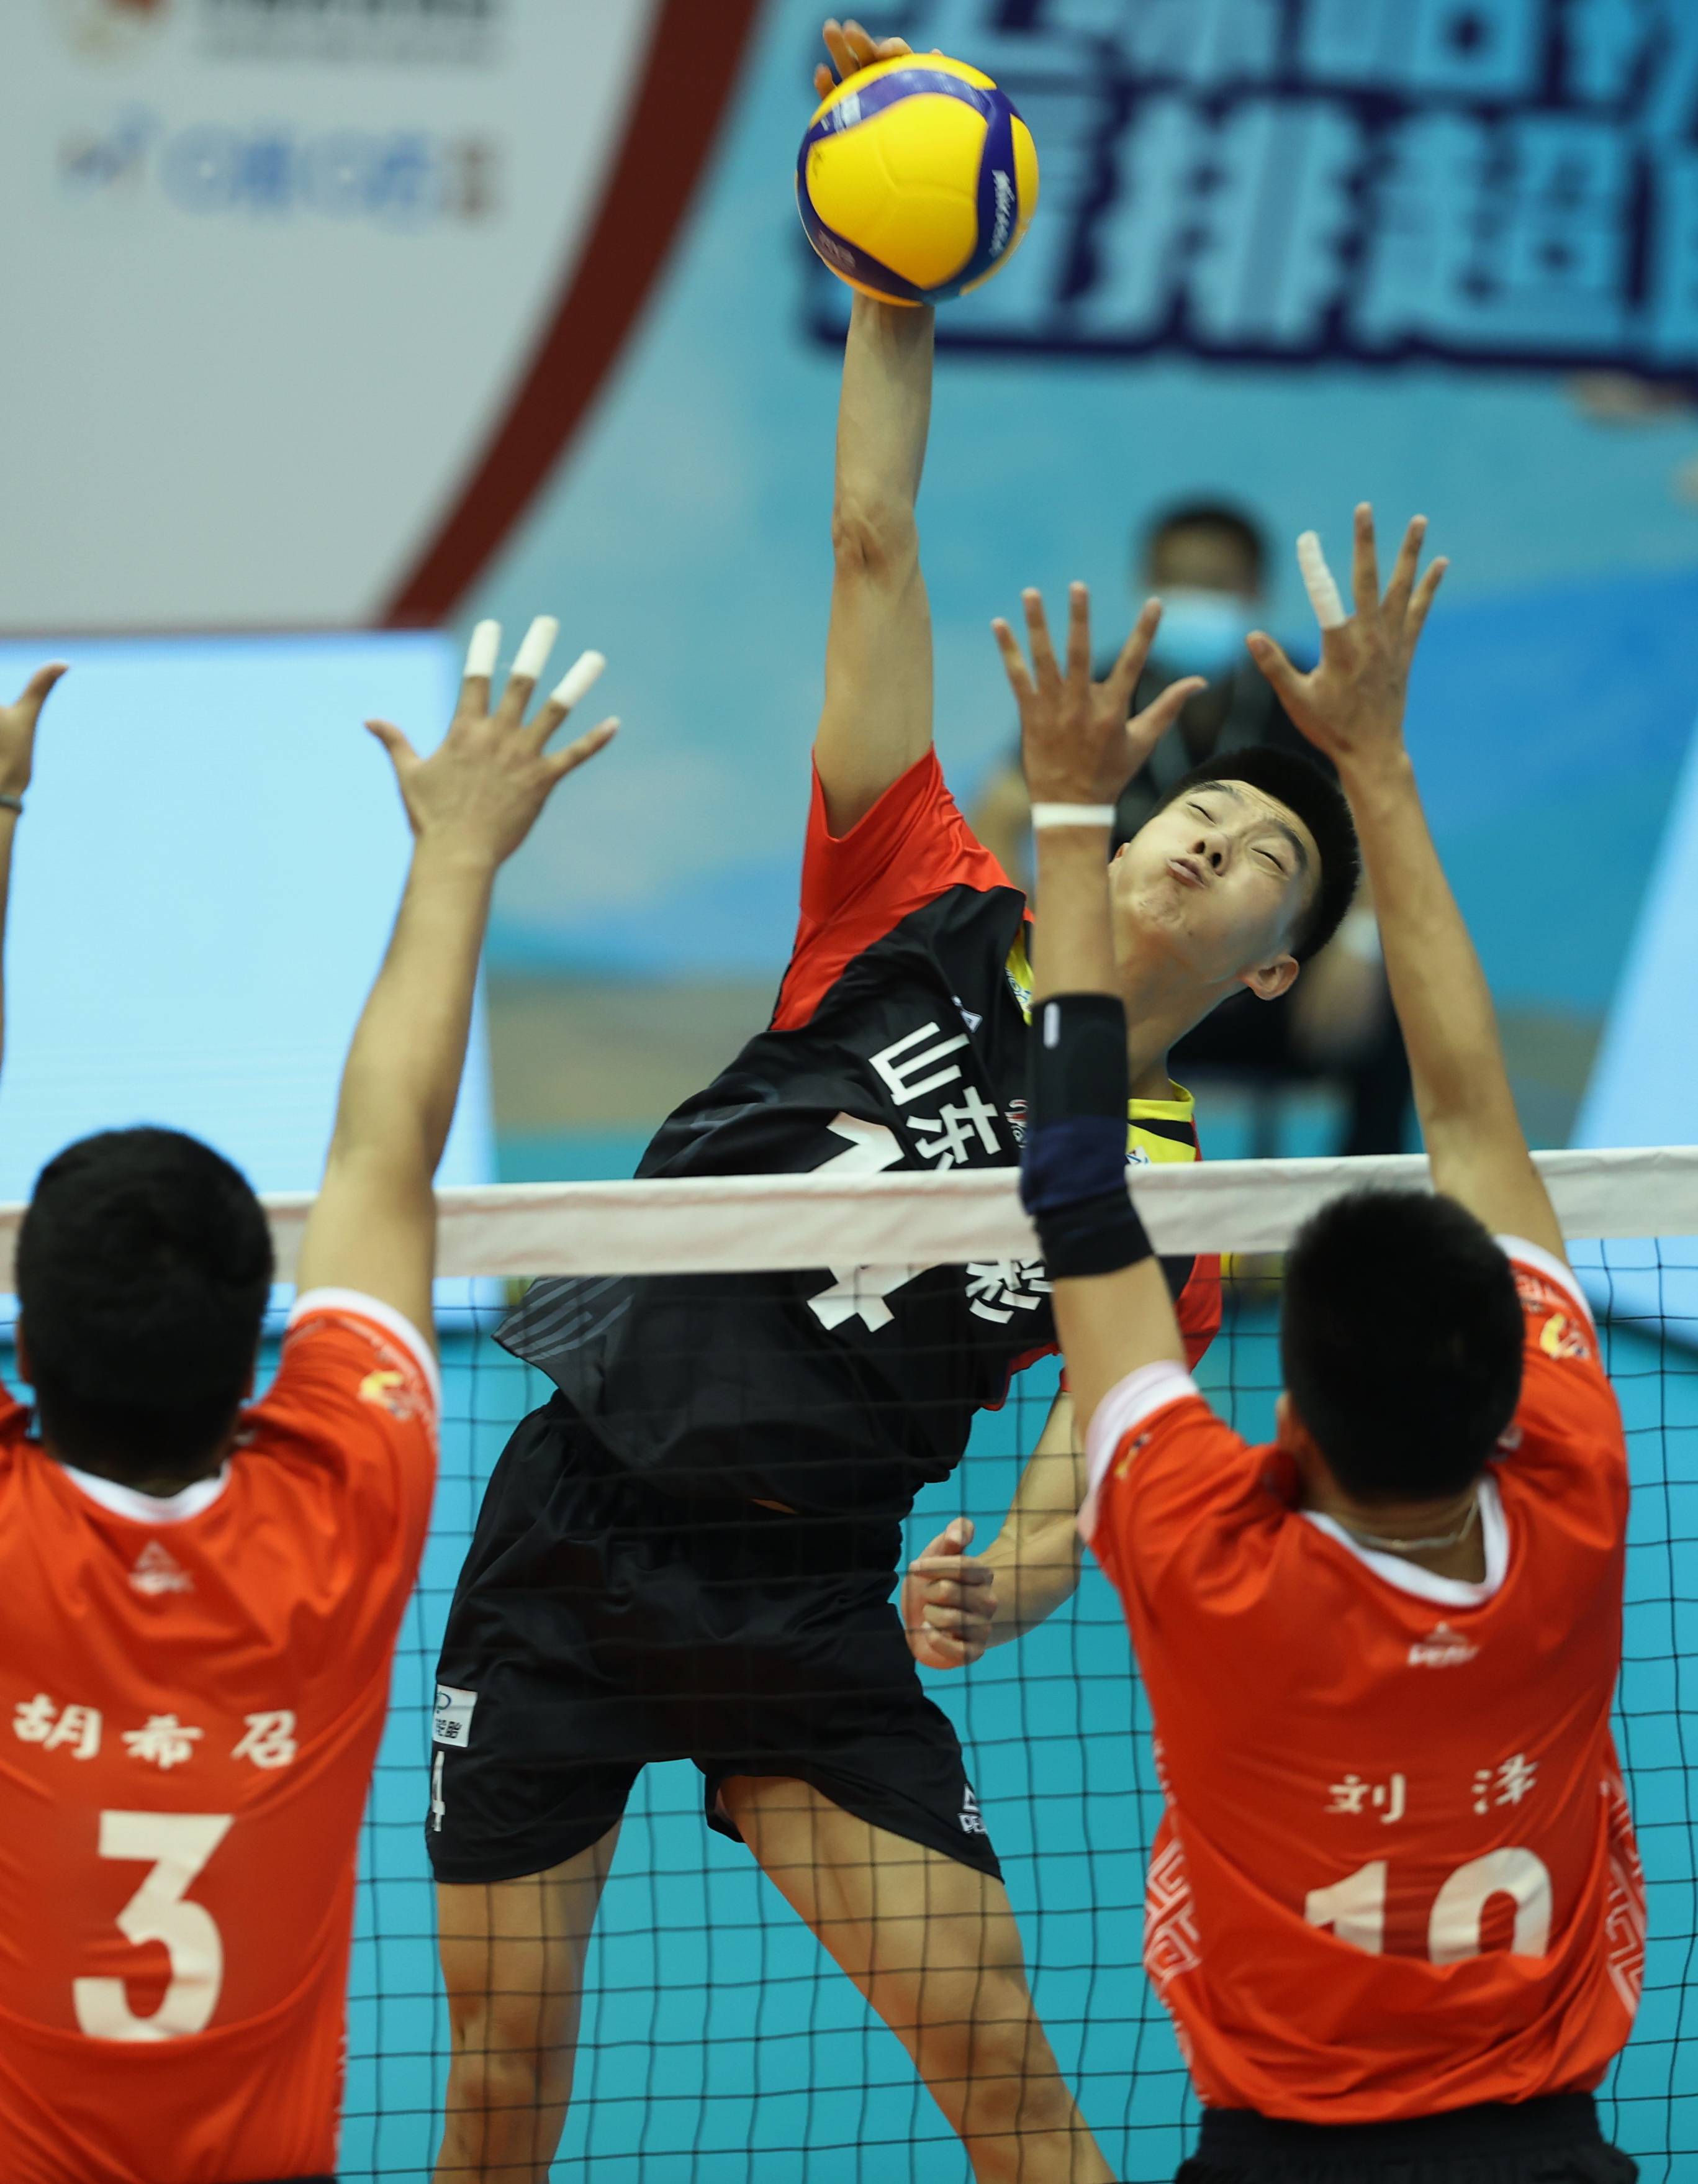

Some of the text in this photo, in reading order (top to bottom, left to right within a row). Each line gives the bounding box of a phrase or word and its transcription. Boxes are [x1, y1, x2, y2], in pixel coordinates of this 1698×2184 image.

[12, 1693, 299, 1770] 胡希召
[72, 1809, 235, 2043] 3
